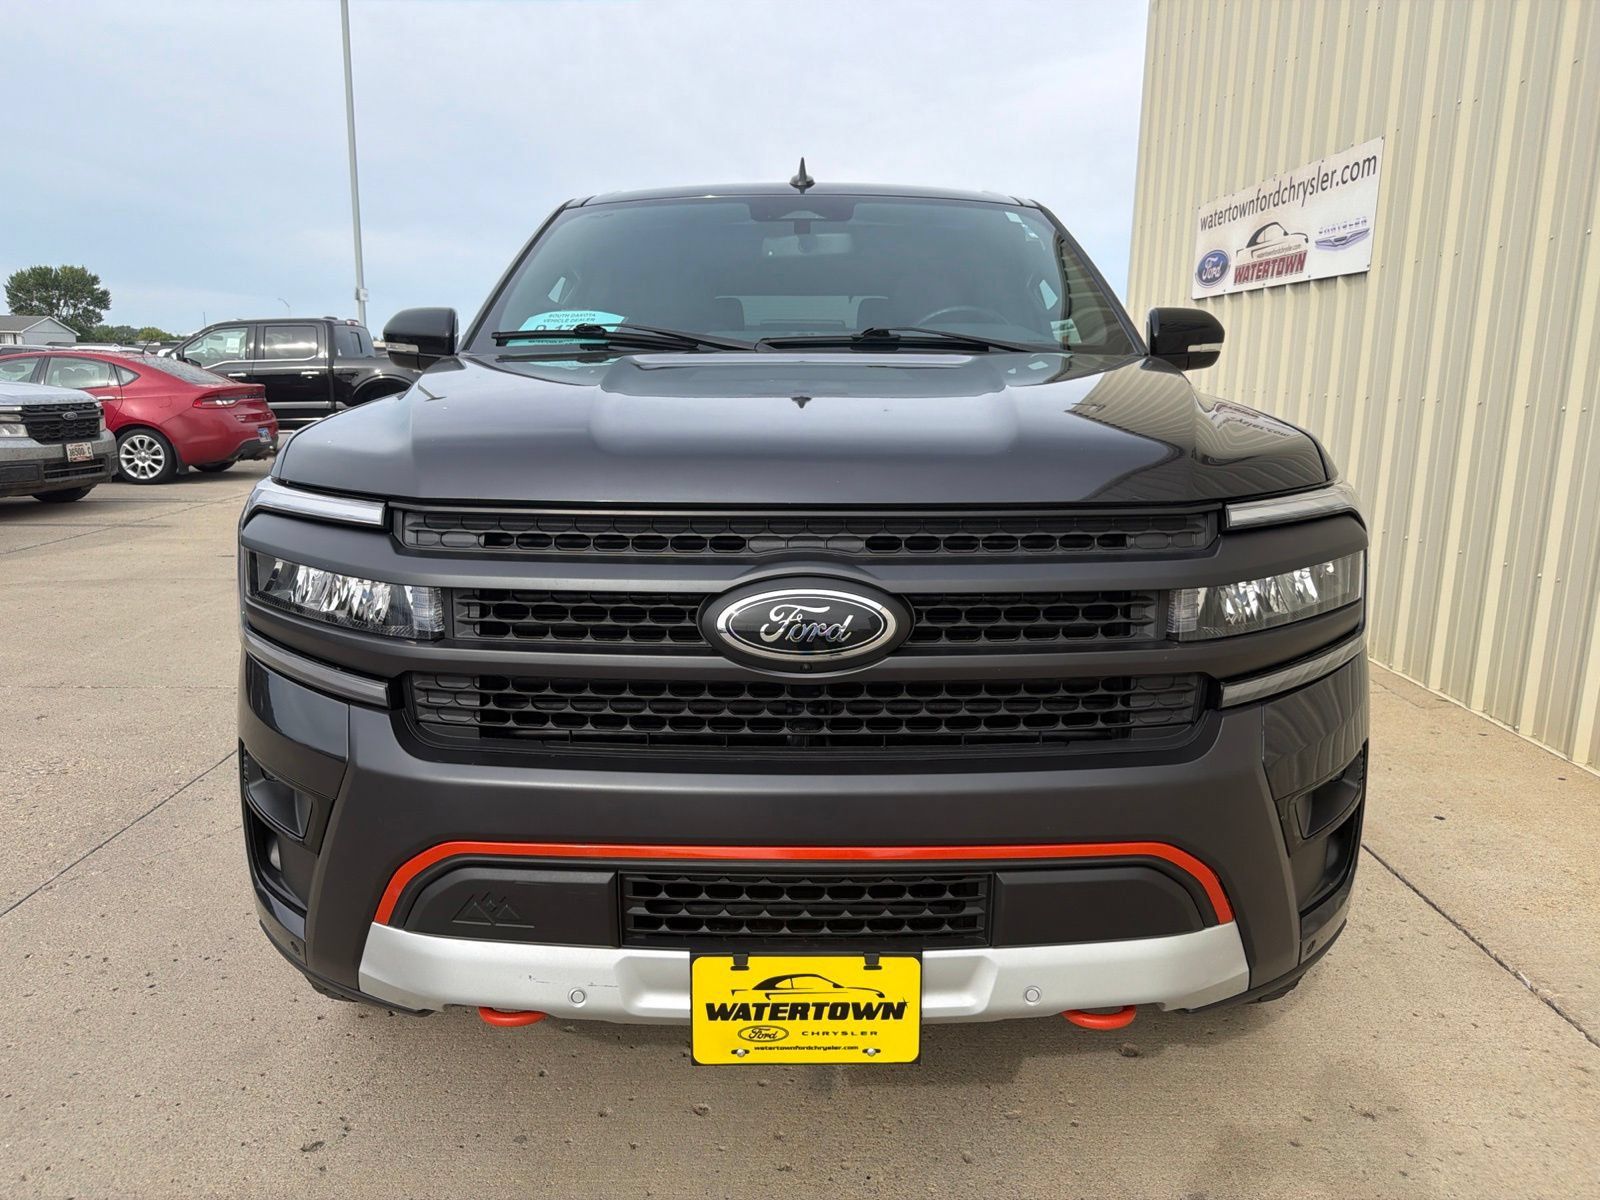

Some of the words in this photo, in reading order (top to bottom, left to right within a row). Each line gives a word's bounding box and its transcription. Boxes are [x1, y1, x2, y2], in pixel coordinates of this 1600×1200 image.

[1200, 154, 1377, 232] watertownfordchrysler.com
[1202, 256, 1222, 280] Ford
[1233, 250, 1308, 285] WATERTOWN
[759, 604, 854, 643] Ford
[705, 1001, 907, 1022] WATERTOWN
[748, 1026, 778, 1040] Ford
